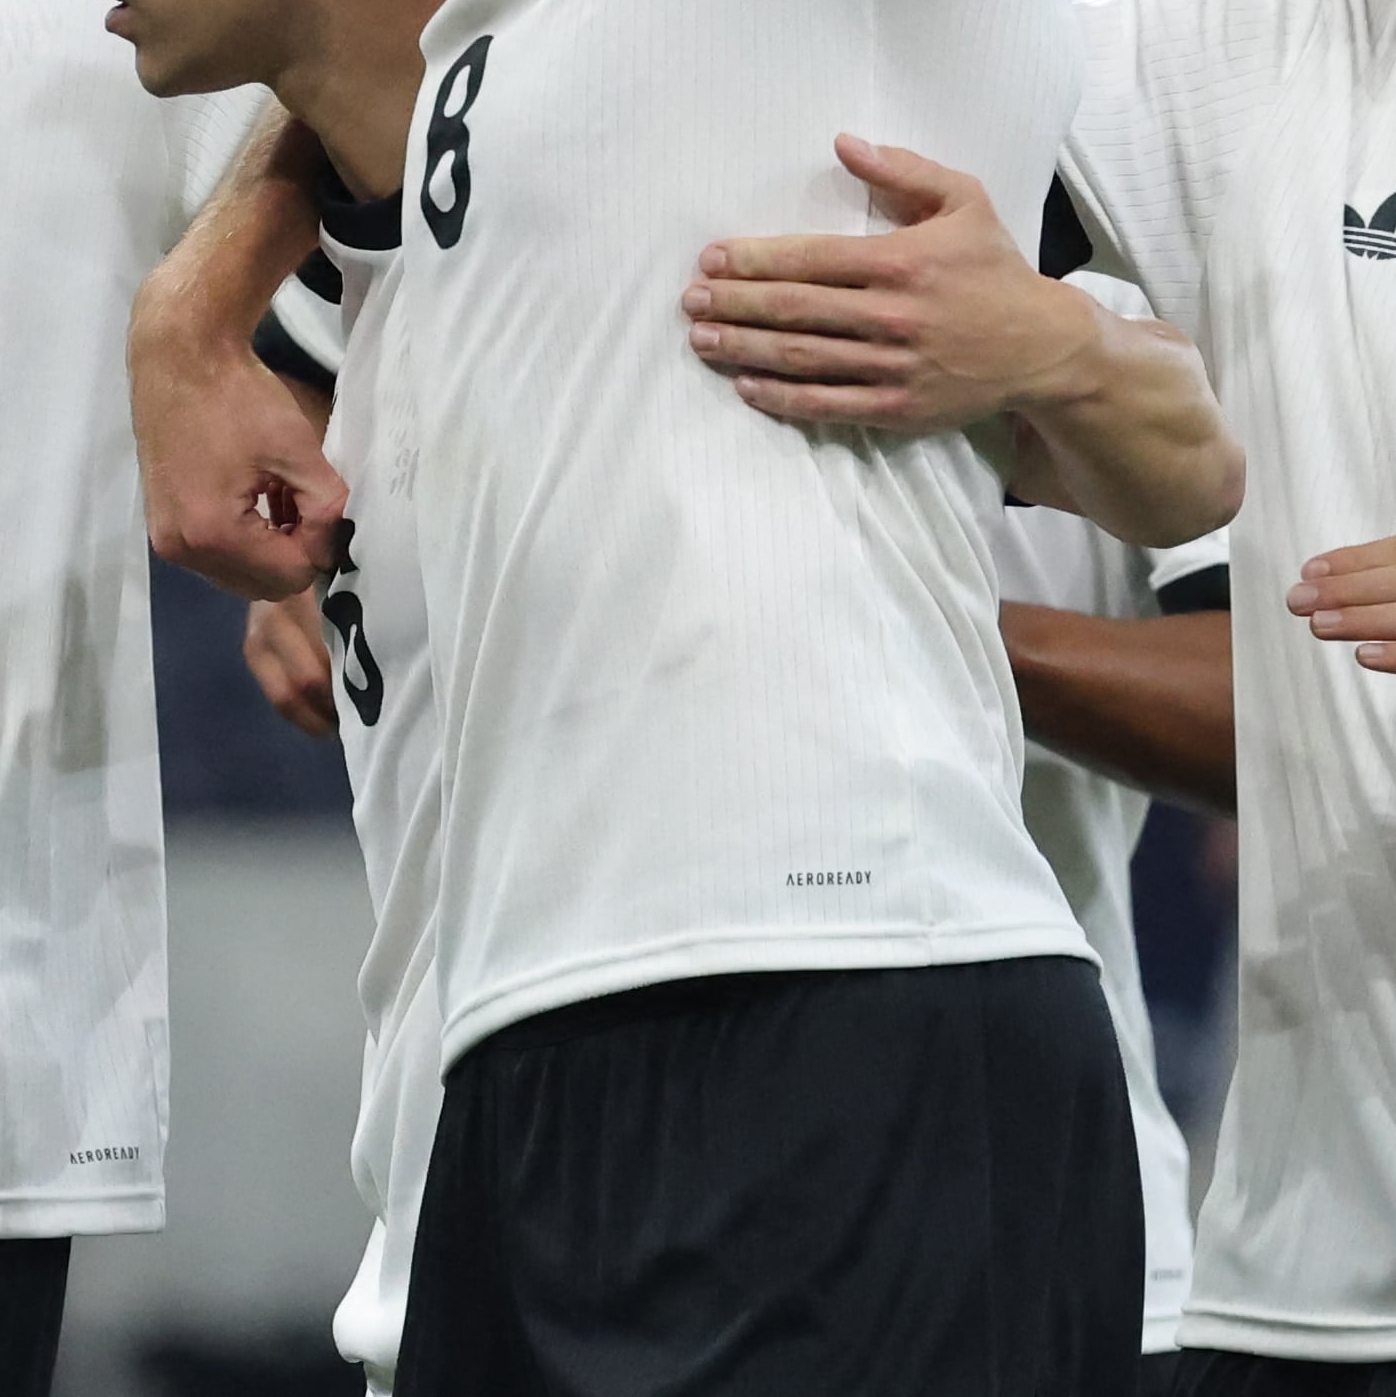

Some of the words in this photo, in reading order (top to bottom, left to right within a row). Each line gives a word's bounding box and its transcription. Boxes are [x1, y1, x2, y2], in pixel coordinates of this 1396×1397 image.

[420, 33, 495, 251] 8
[785, 870, 872, 887] AEROREADY
[69, 1145, 141, 1165] AEROREADY
